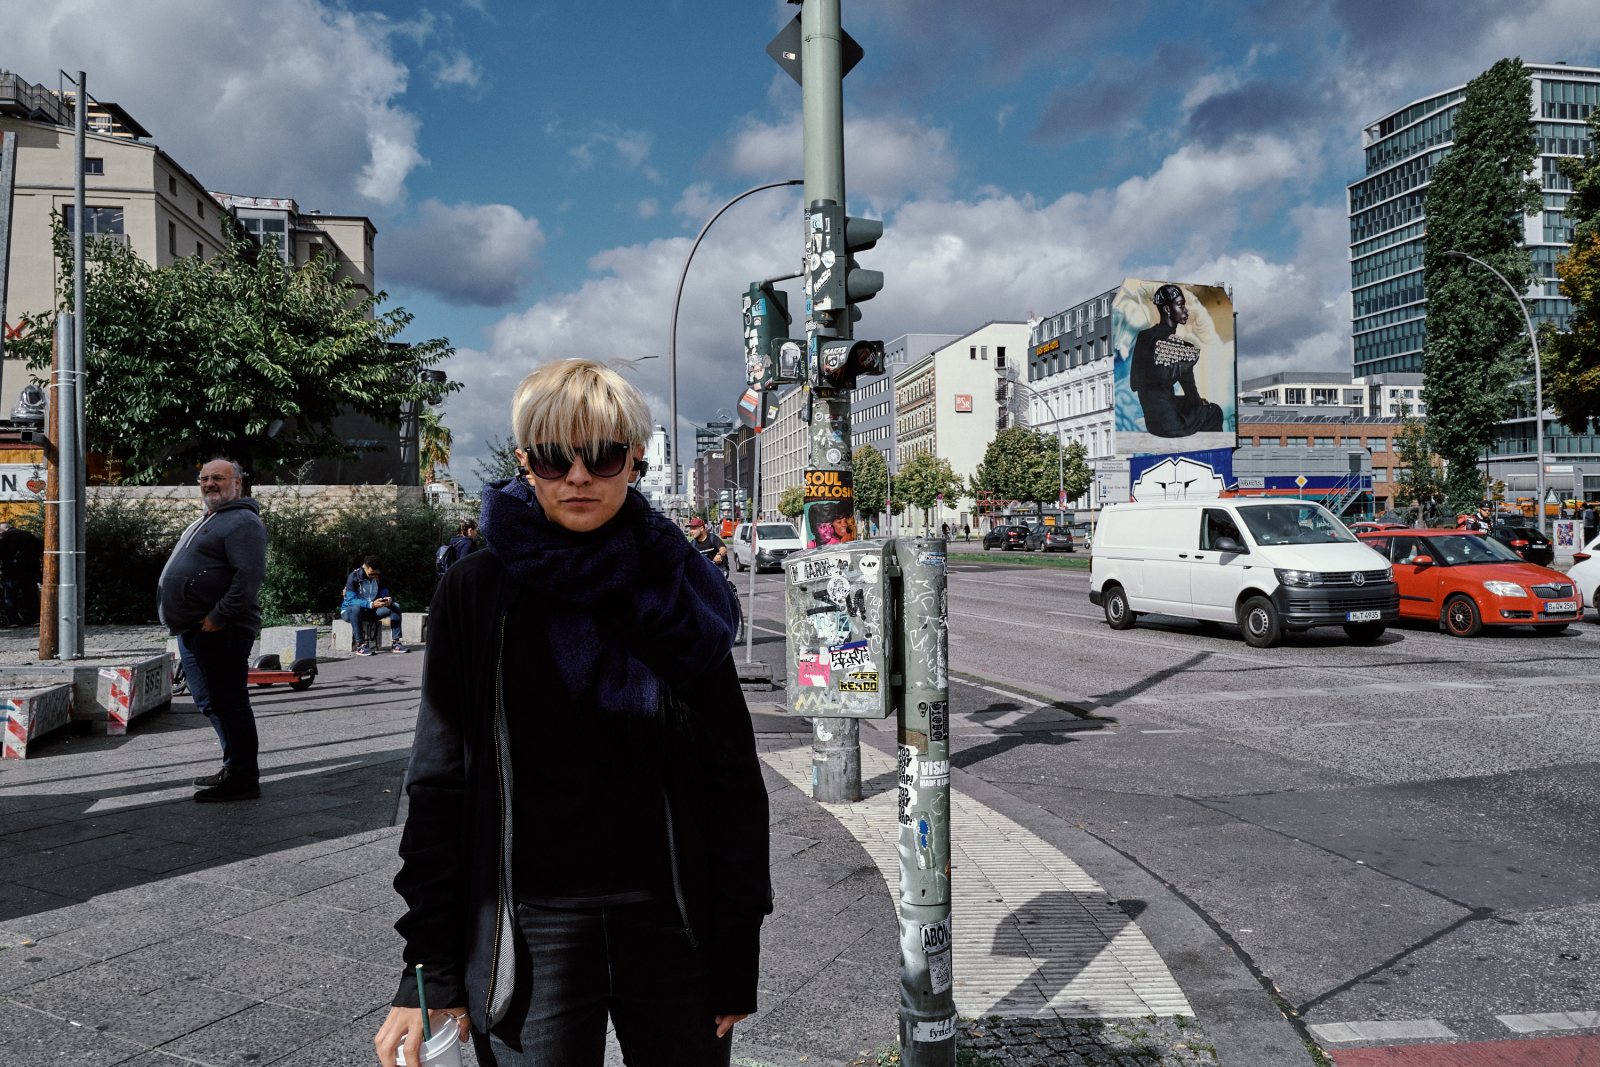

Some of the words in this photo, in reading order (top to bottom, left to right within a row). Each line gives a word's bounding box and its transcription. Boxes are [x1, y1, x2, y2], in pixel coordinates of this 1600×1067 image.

[957, 397, 970, 409] BSR
[805, 472, 841, 486] SOUL
[1364, 611, 1379, 619] 4935
[145, 671, 161, 694] BSG
